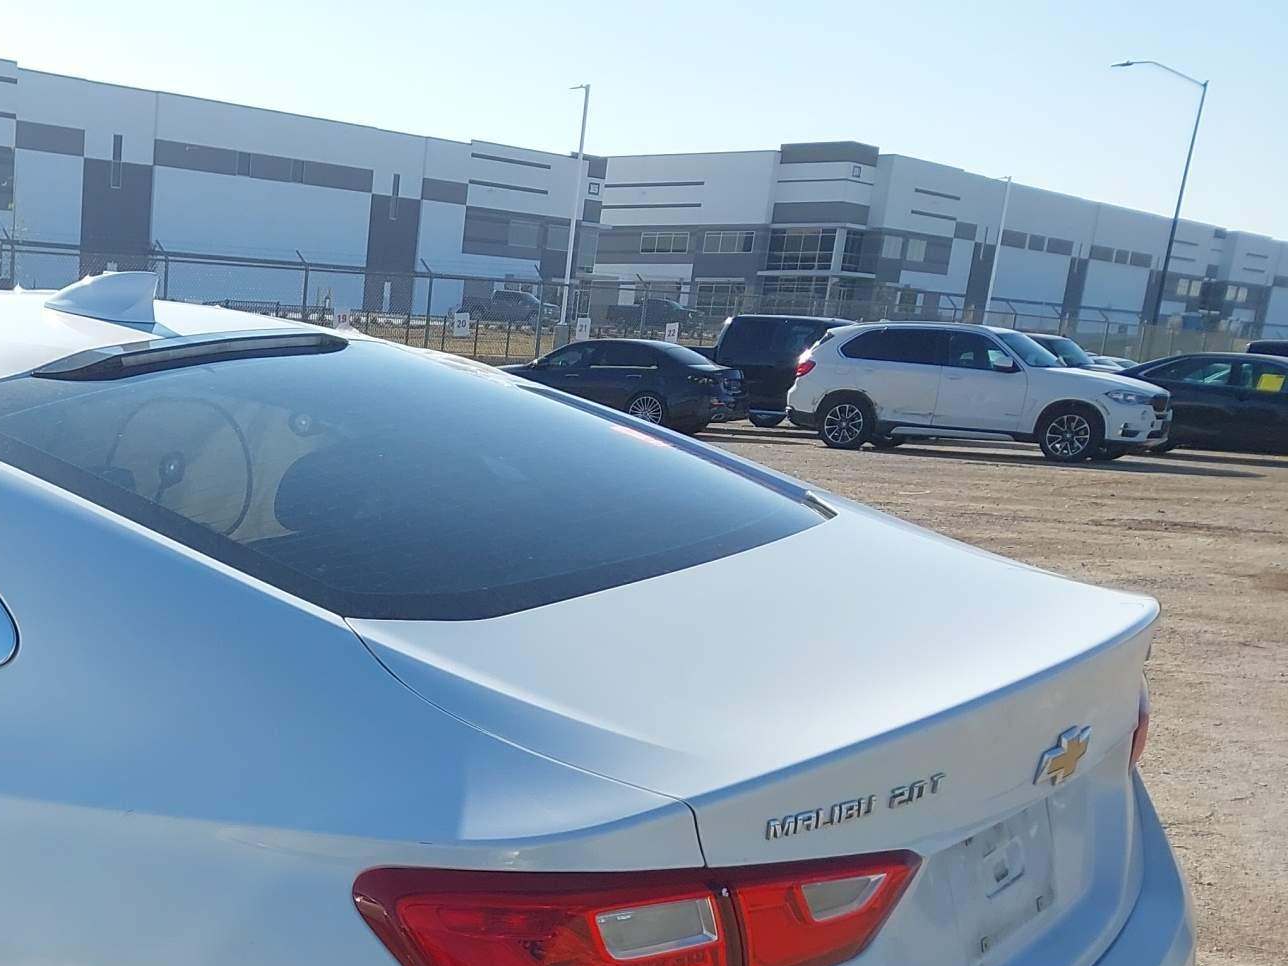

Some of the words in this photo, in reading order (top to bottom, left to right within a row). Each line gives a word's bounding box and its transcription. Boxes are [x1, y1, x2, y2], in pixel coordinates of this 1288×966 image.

[457, 319, 467, 329] 20
[579, 323, 588, 333] 21
[667, 328, 677, 338] 22
[765, 794, 877, 841] MALIBU
